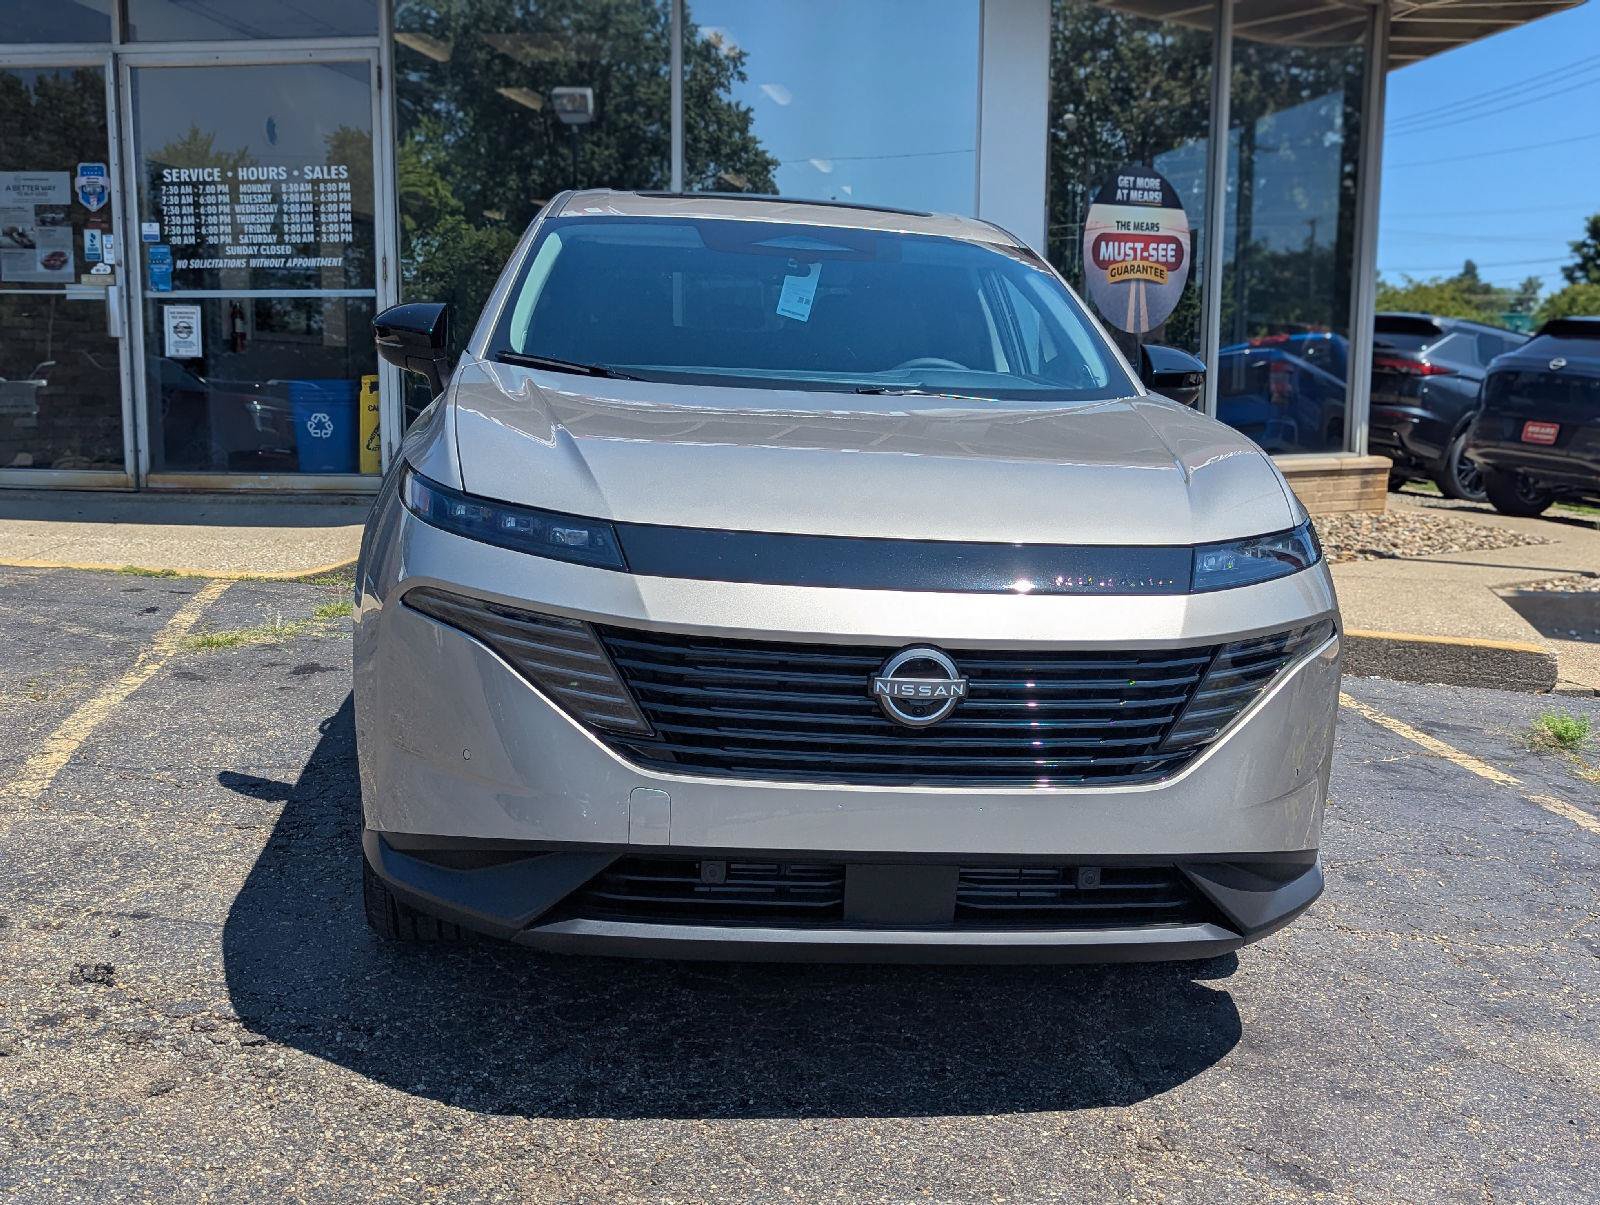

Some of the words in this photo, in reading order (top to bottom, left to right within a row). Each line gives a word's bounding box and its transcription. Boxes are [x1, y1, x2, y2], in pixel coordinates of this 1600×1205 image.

[162, 167, 222, 182] SERVICE
[238, 166, 288, 180] HOURS
[304, 165, 348, 180] SALES
[161, 185, 179, 194] 7:30
[180, 184, 192, 194] AM
[217, 184, 230, 193] PM
[240, 184, 272, 193] MONDAY
[282, 183, 299, 192] 8:30
[300, 182, 312, 192] AM
[320, 182, 338, 192] 8:00
[338, 182, 351, 191] PM
[1118, 175, 1135, 188] GET
[1136, 176, 1161, 190] MORE
[162, 196, 180, 204] 7:30
[181, 195, 194, 204] AM
[200, 194, 217, 204] 6:00
[218, 194, 230, 204] PM
[240, 194, 272, 204] TUESDAY
[282, 193, 300, 202] 9:00
[301, 192, 313, 202] AM
[320, 192, 338, 202] 6:00
[339, 192, 352, 201] PM
[1116, 189, 1128, 201] AT
[1130, 190, 1162, 202] MEARS!
[162, 206, 180, 215] 7:30
[182, 205, 194, 214] AM
[200, 204, 217, 214] 6:00
[218, 204, 230, 214] PM
[234, 204, 278, 213] WEDNESDAY
[283, 204, 300, 213] 9:00
[301, 203, 314, 212] AM
[320, 203, 338, 212] 6:00
[340, 202, 352, 212] PM
[164, 216, 181, 225] 7:30
[182, 215, 195, 224] AM
[201, 215, 218, 224] 7:00
[219, 214, 231, 224] PM
[236, 214, 274, 224] THURSDAY
[283, 213, 300, 223] 8:30
[301, 212, 314, 222] AM
[320, 212, 339, 222] 8:00
[340, 212, 352, 222] PM
[164, 226, 182, 235] 7:30
[182, 225, 195, 234] AM
[201, 225, 219, 235] 6:00
[220, 225, 232, 234] PM
[244, 224, 271, 234] FRIDAY
[284, 224, 301, 233] 9:00
[301, 223, 314, 233] AM
[321, 223, 339, 233] 6:00
[340, 222, 353, 232] PM
[1116, 220, 1132, 231] THE
[1132, 221, 1160, 232] MEARS
[183, 235, 196, 245] AM
[220, 234, 232, 244] PM
[239, 234, 278, 244] SATURDAY
[284, 233, 301, 244] 9:00
[302, 233, 315, 243] AM
[340, 232, 353, 242] PM
[225, 245, 258, 255] SUNDAY
[260, 245, 292, 254] CLOSED
[1100, 240, 1176, 262] MUST-SEE
[176, 259, 188, 269] NO
[189, 259, 247, 269] SOLICITATIONS
[249, 258, 287, 268] WITHOUT
[286, 257, 343, 267] APPOINTMENT
[1110, 263, 1165, 279] GUARANTEE
[876, 681, 964, 696] NISSAN
